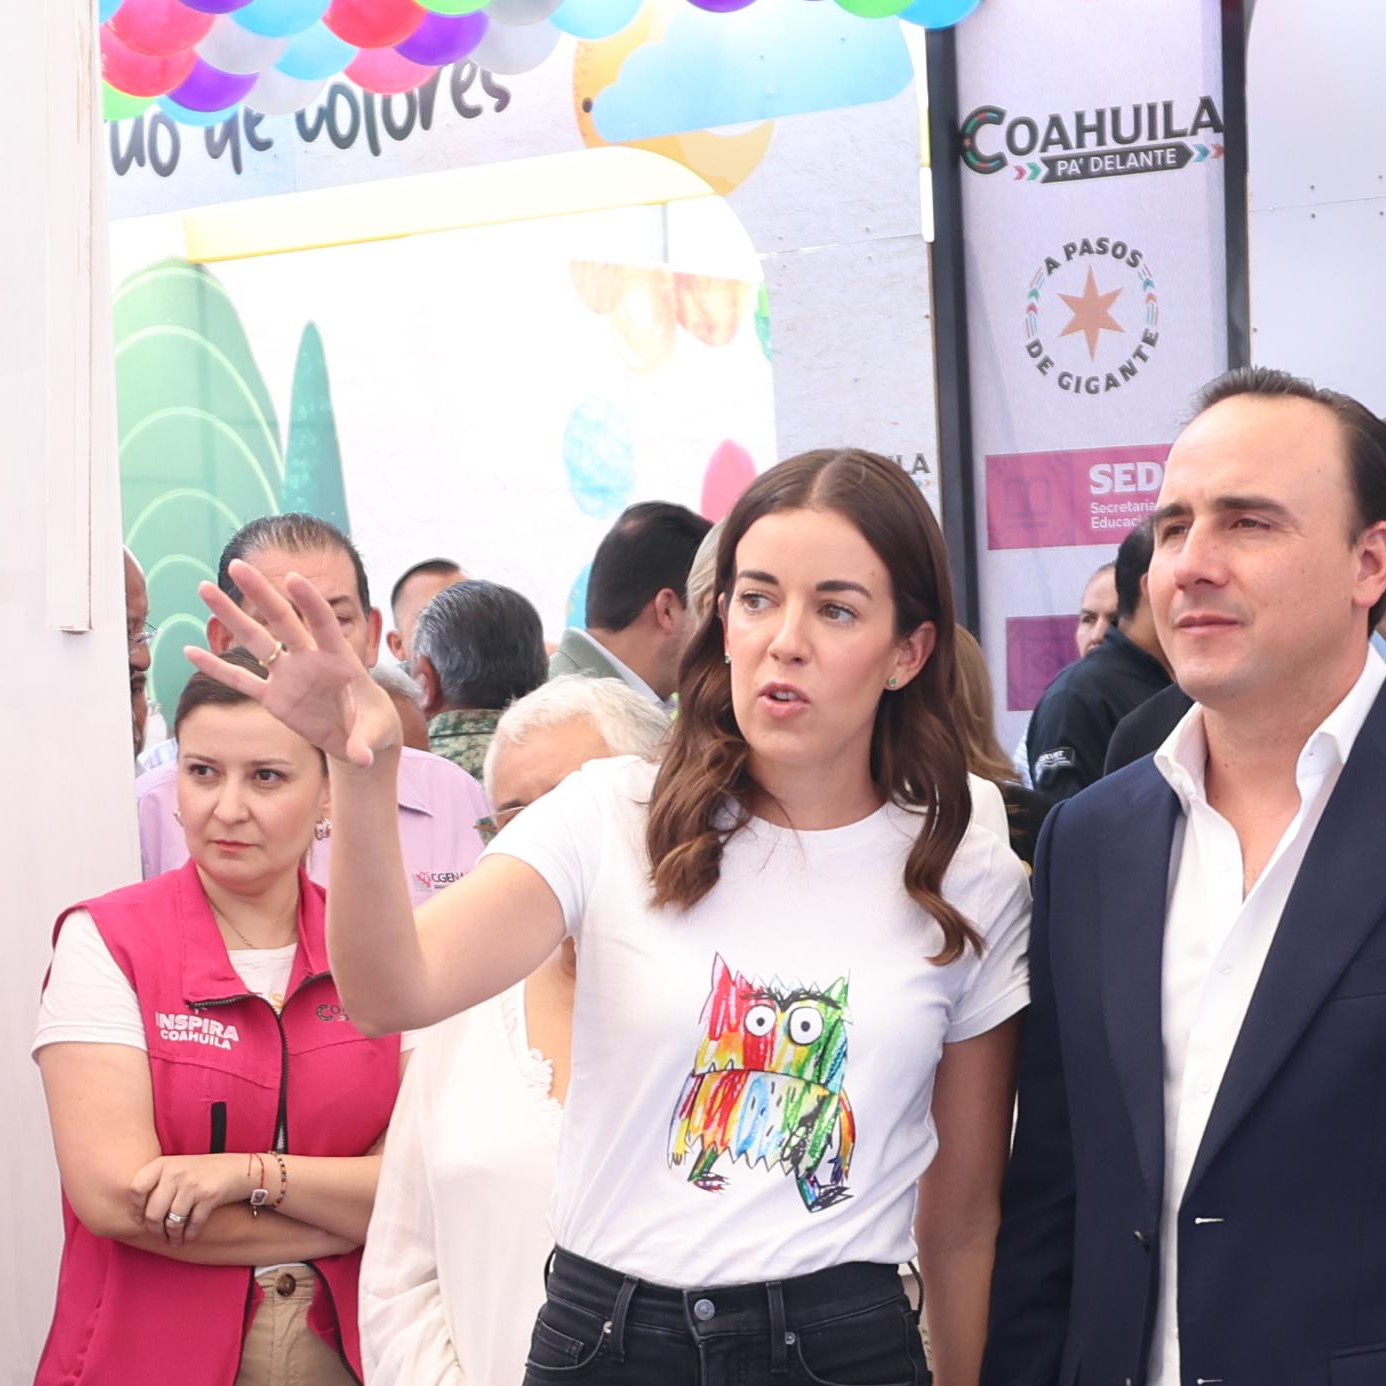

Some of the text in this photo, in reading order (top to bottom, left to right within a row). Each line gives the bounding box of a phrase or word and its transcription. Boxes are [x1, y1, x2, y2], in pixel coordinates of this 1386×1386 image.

[960, 95, 1225, 175] COAHUILA
[1090, 148, 1178, 173] DELANTE
[1044, 237, 1143, 276] A PASOS
[1025, 328, 1160, 394] DE GIGANTE
[1089, 461, 1166, 495] SED
[1091, 515, 1142, 529] Educaci
[155, 1011, 239, 1042] INSPIRA
[160, 1029, 232, 1050] COAHUILA
